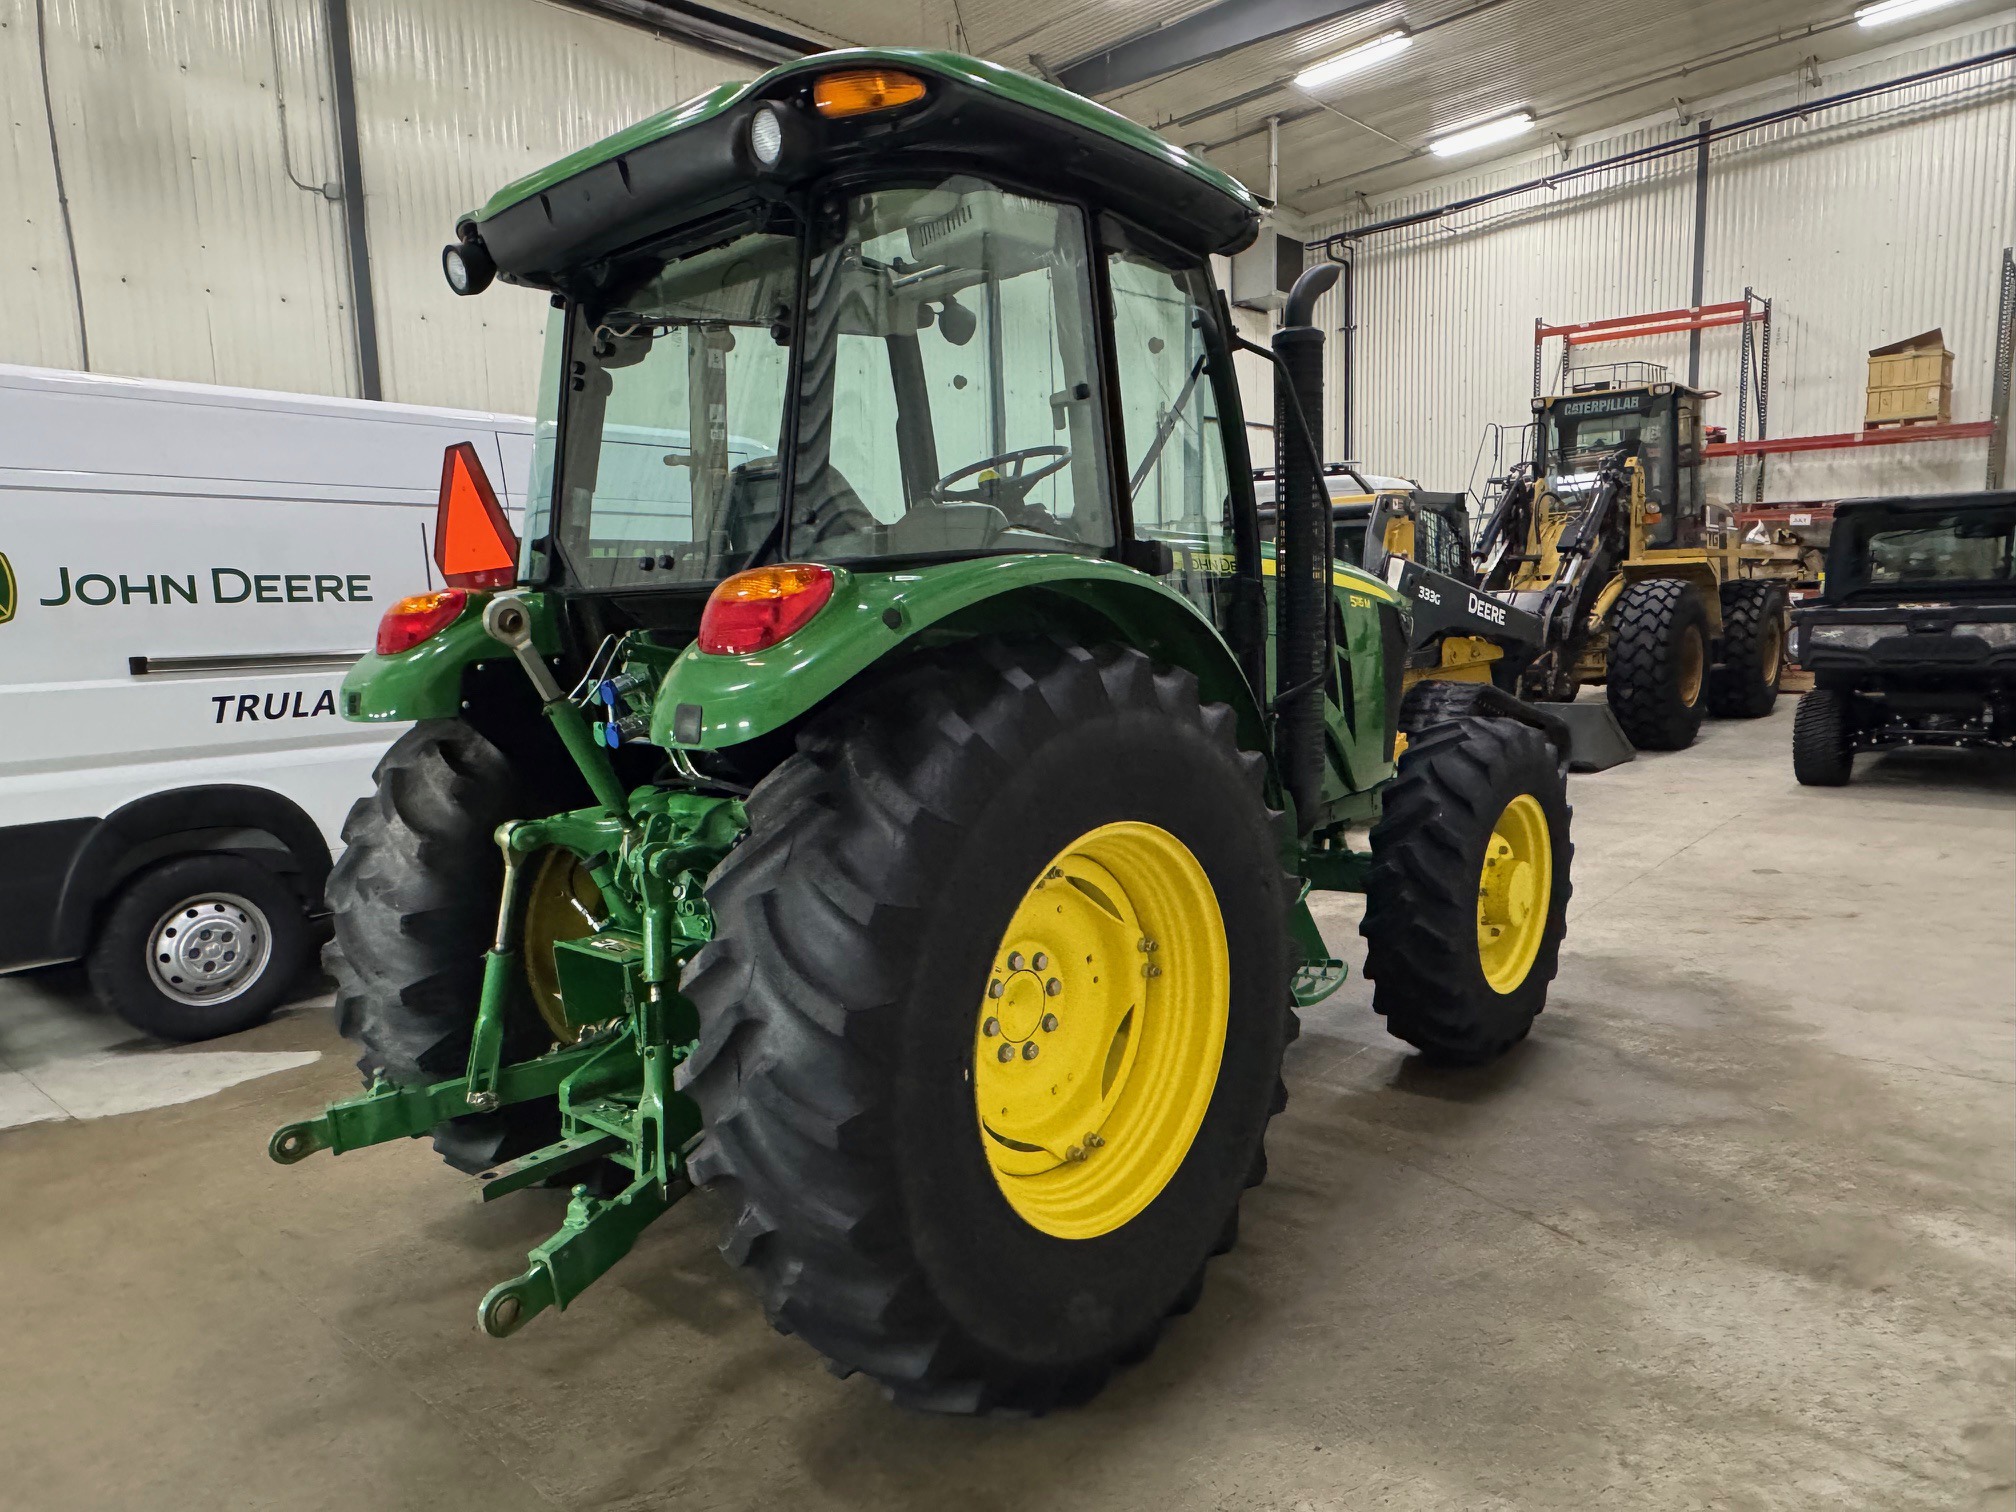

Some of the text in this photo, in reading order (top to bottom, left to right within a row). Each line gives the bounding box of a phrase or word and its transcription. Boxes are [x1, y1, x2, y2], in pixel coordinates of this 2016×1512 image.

[1564, 396, 1640, 416] CATERPILLAR
[39, 566, 374, 607] JOHN DEERE
[1417, 585, 1441, 606] 333G
[1467, 592, 1507, 626] DEERE
[211, 688, 337, 724] TRULA
